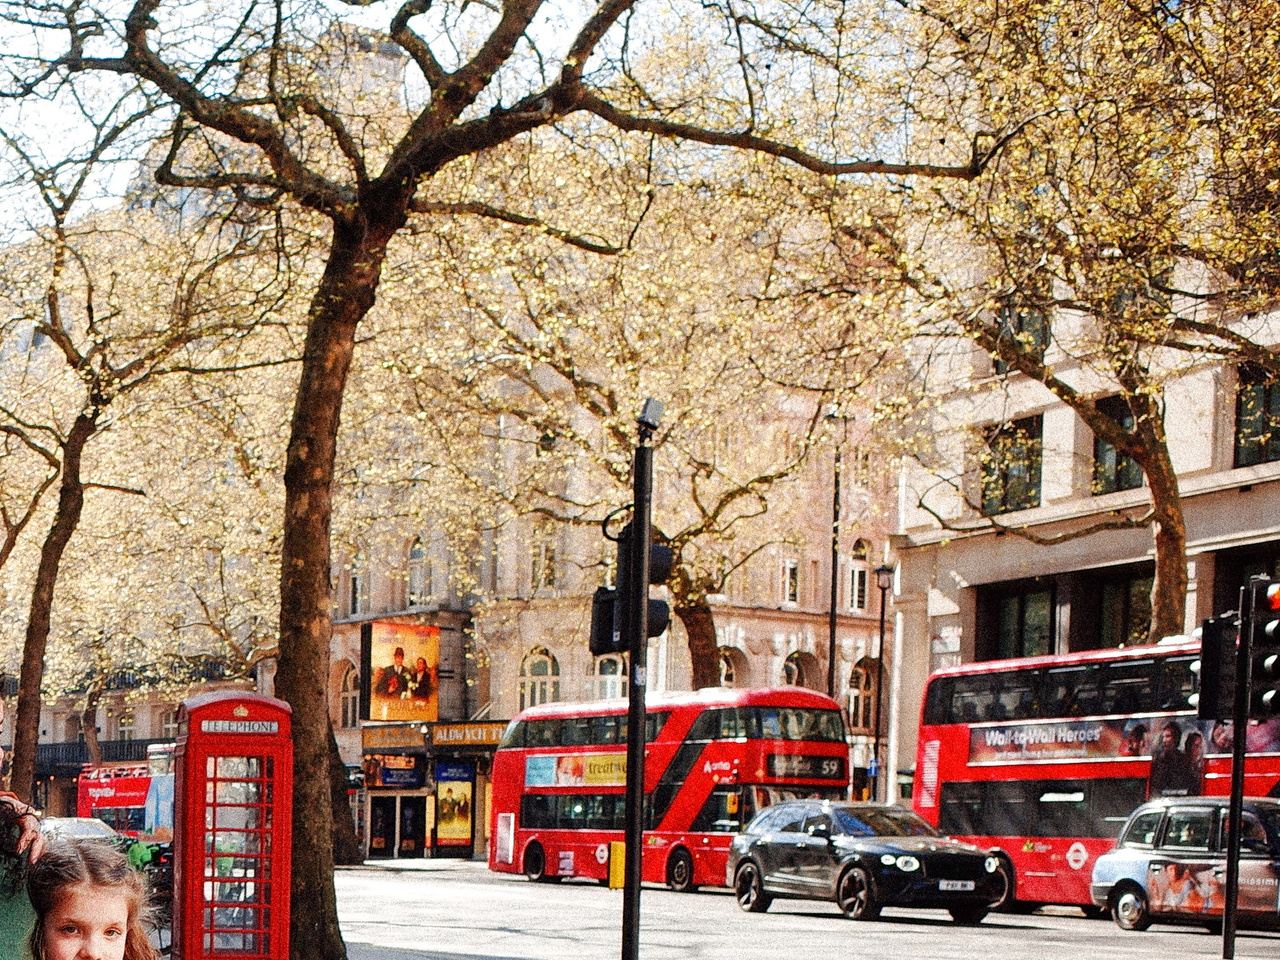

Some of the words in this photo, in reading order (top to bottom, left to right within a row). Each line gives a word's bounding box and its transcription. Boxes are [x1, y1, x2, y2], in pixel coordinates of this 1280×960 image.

[206, 721, 275, 732] TELEPHONE
[436, 728, 486, 742] ALDWYCH
[821, 759, 838, 775] 59
